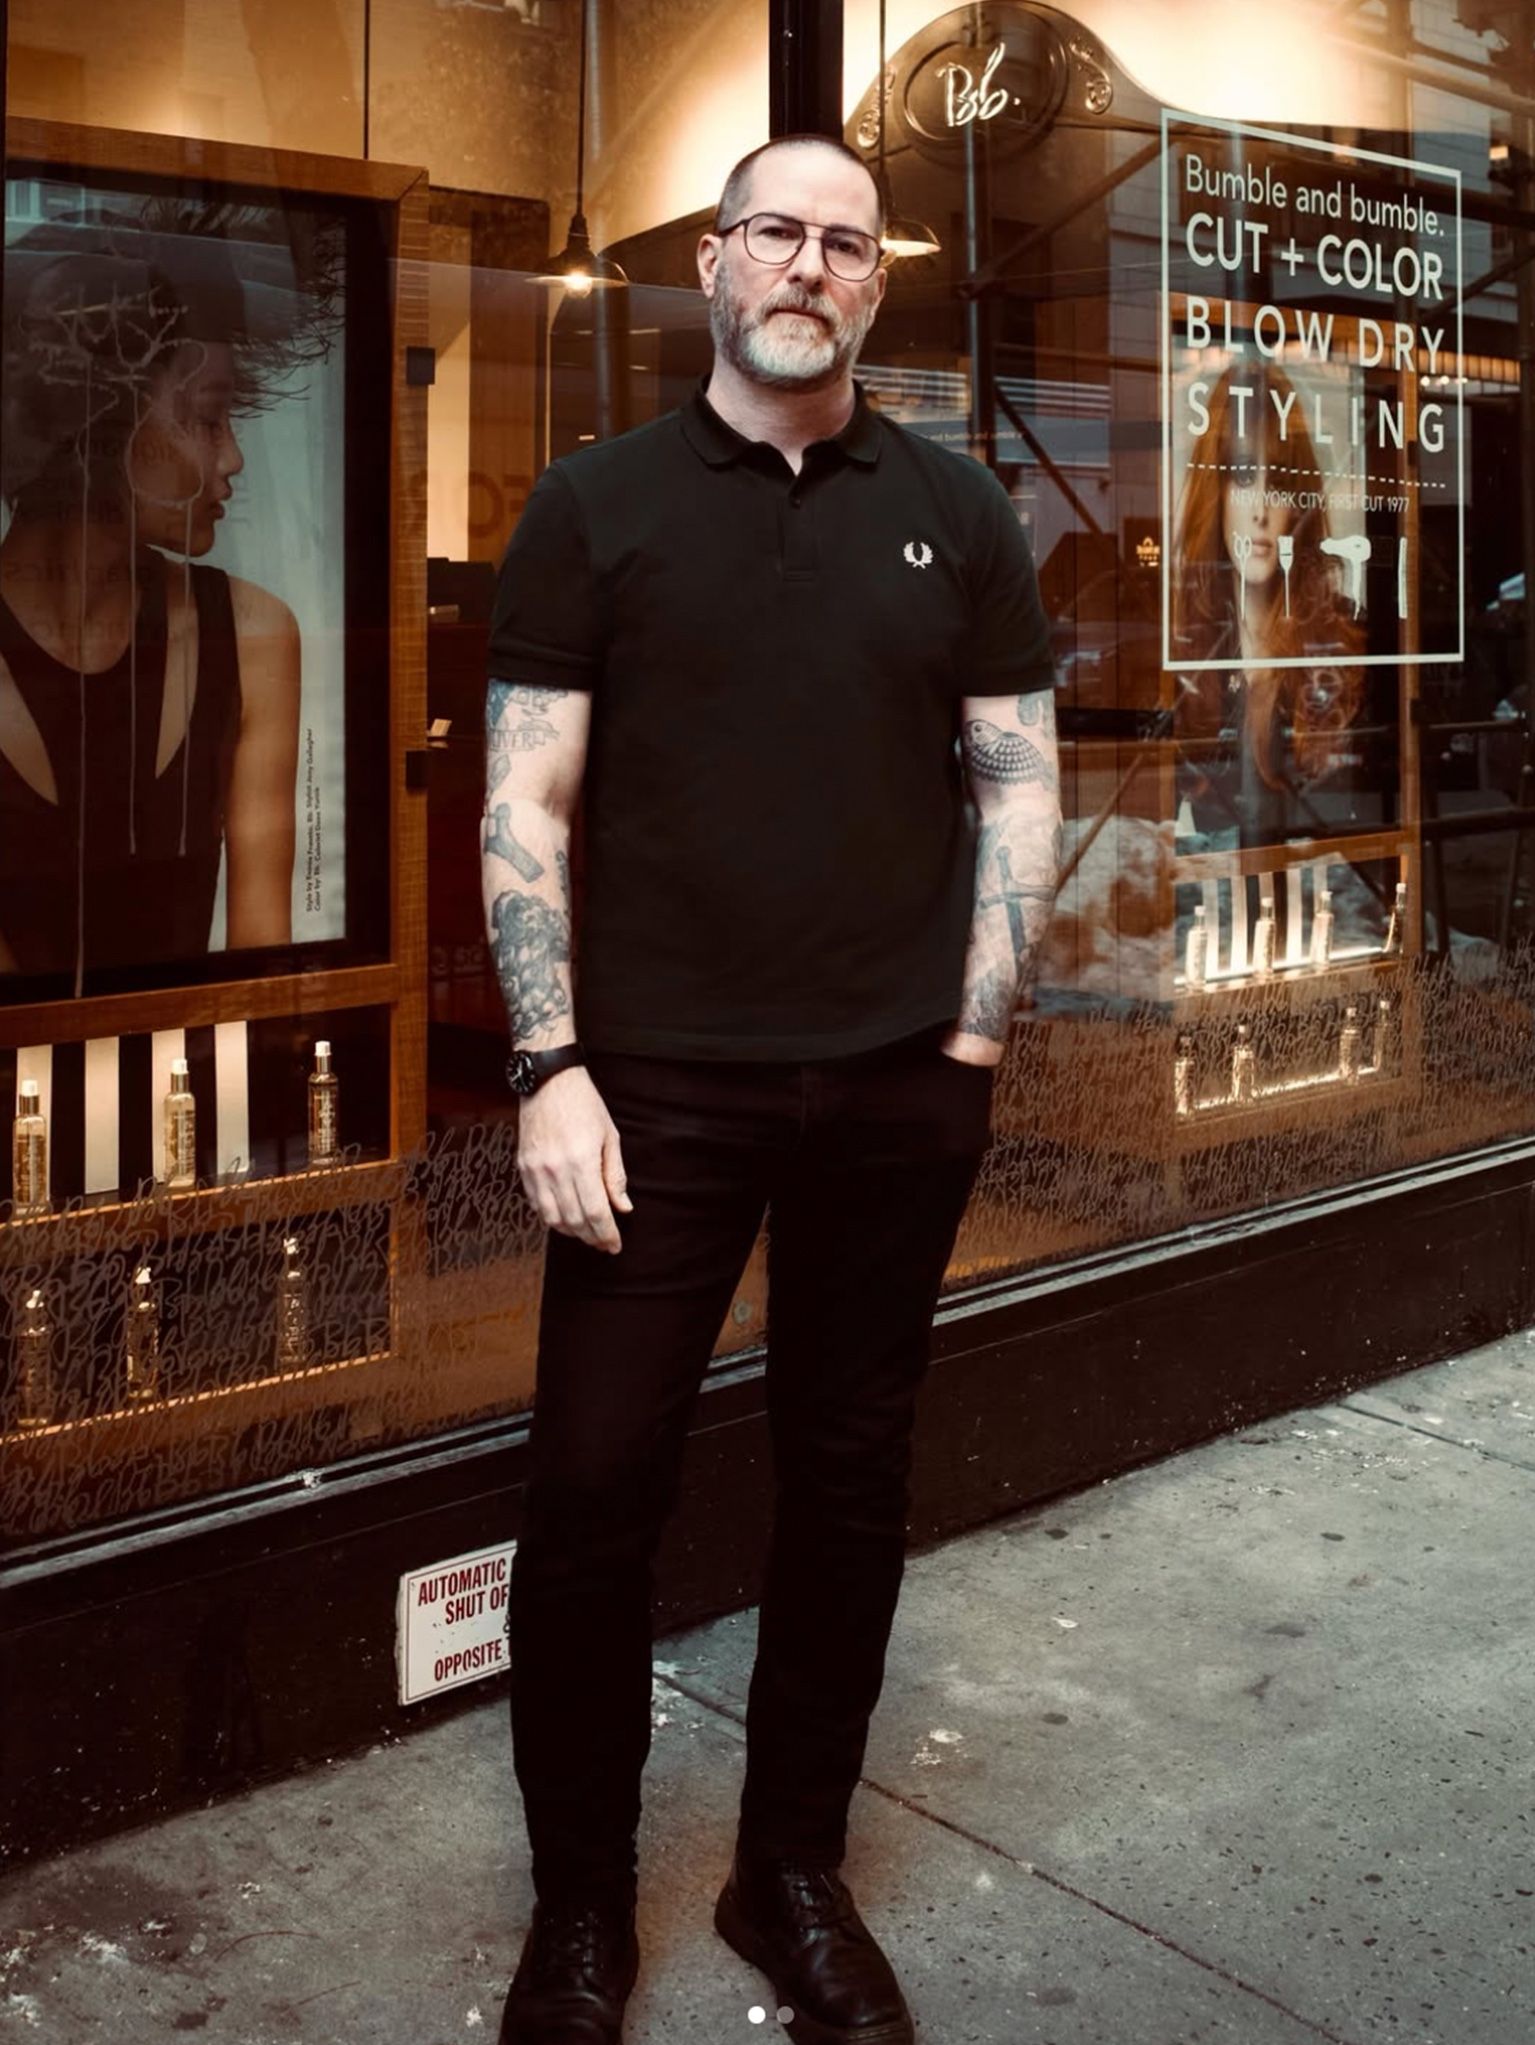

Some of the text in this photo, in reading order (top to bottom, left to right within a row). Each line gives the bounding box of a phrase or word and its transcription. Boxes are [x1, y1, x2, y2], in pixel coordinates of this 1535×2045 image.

[1186, 154, 1445, 237] Bumble and bumble.
[1186, 212, 1443, 300] CUT + COLOR
[1186, 296, 1444, 374] BLOW DRY
[1187, 382, 1445, 453] STYLING
[1262, 490, 1297, 509] YORK
[1361, 495, 1384, 513] CUT
[1387, 496, 1410, 513] 1977
[418, 1558, 506, 1607] AUTOMATIC
[445, 1591, 485, 1625] SHUT
[434, 1639, 502, 1682] OPPOSITE
